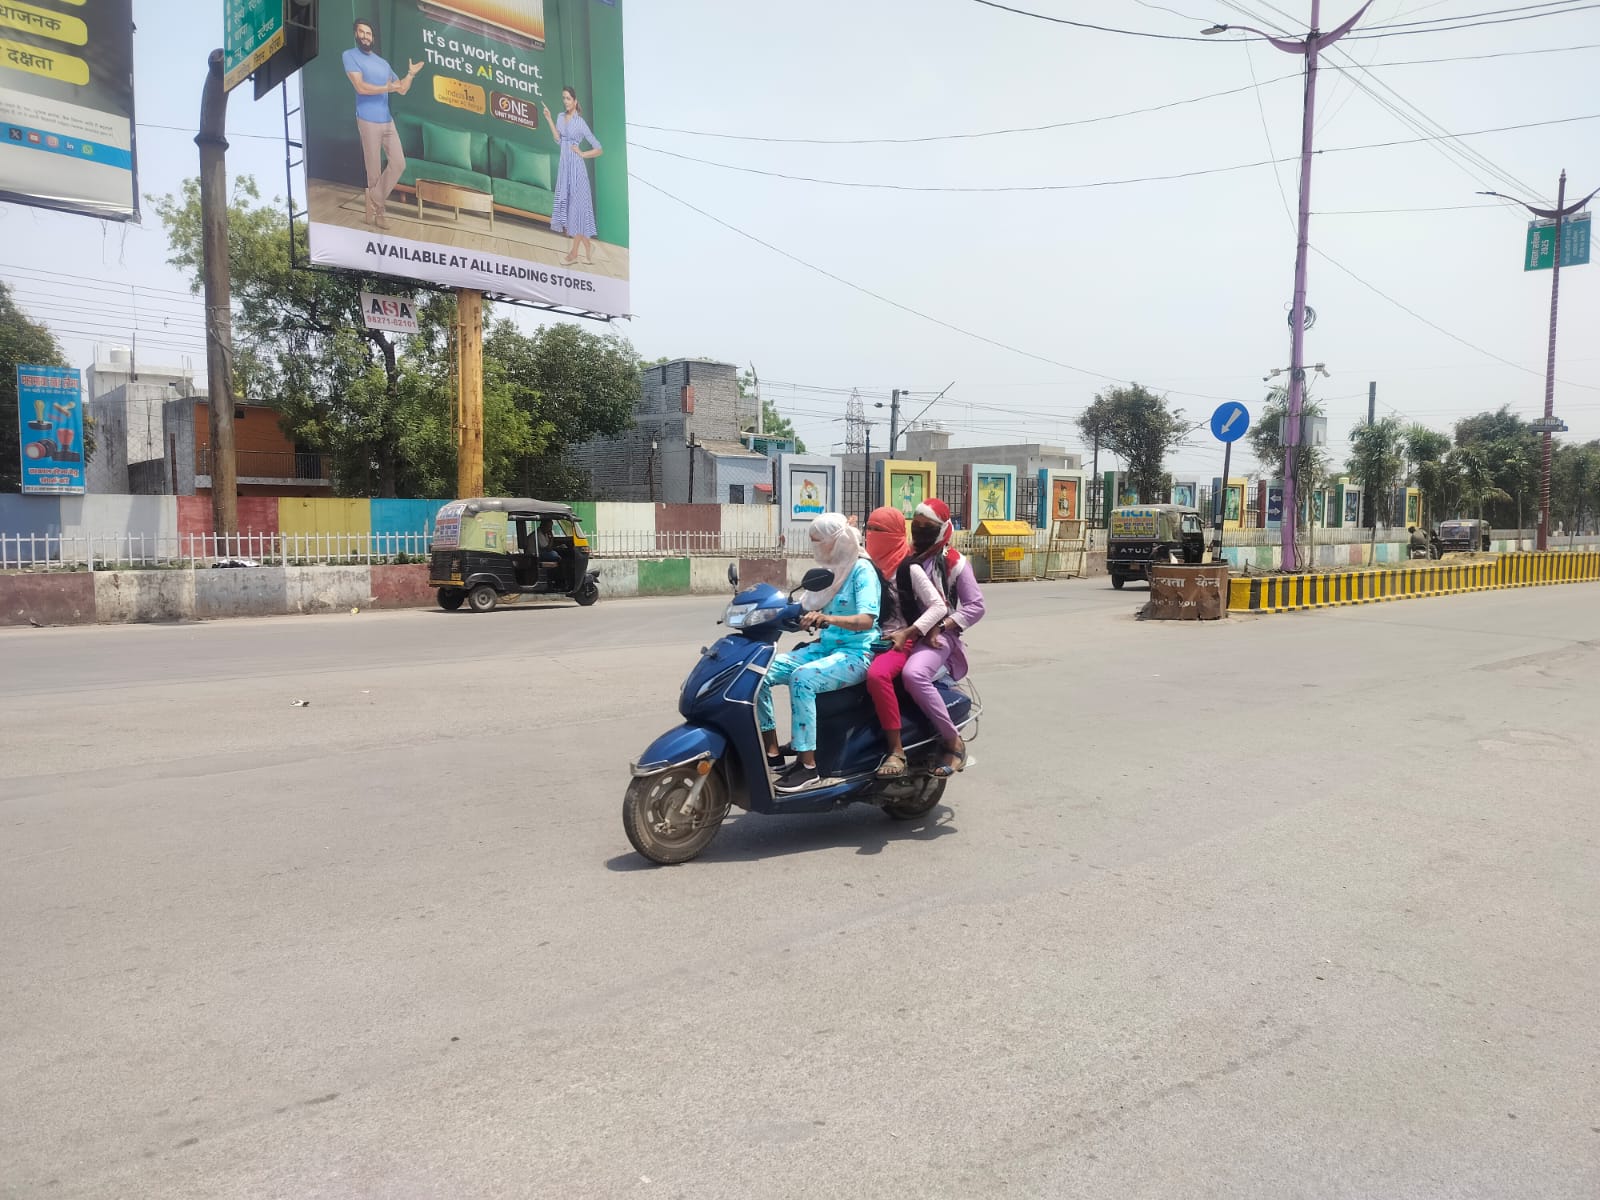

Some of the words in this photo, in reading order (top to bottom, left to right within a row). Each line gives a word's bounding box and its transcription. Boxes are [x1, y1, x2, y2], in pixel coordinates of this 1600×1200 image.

[6, 47, 54, 71] दक्षता
[423, 29, 446, 48] It's
[448, 39, 460, 53] a
[462, 43, 500, 66] work
[502, 56, 516, 70] of
[519, 62, 543, 80] art.
[424, 48, 473, 75] That's
[476, 64, 493, 81] Ai
[495, 70, 543, 97] Smart.
[499, 97, 529, 118] ONE
[365, 241, 447, 266] AVAILABLE
[449, 255, 468, 269] AT
[470, 258, 493, 274] ALL
[496, 262, 548, 283] LEADING
[550, 273, 596, 292] STORES.
[371, 298, 412, 319] ASA
